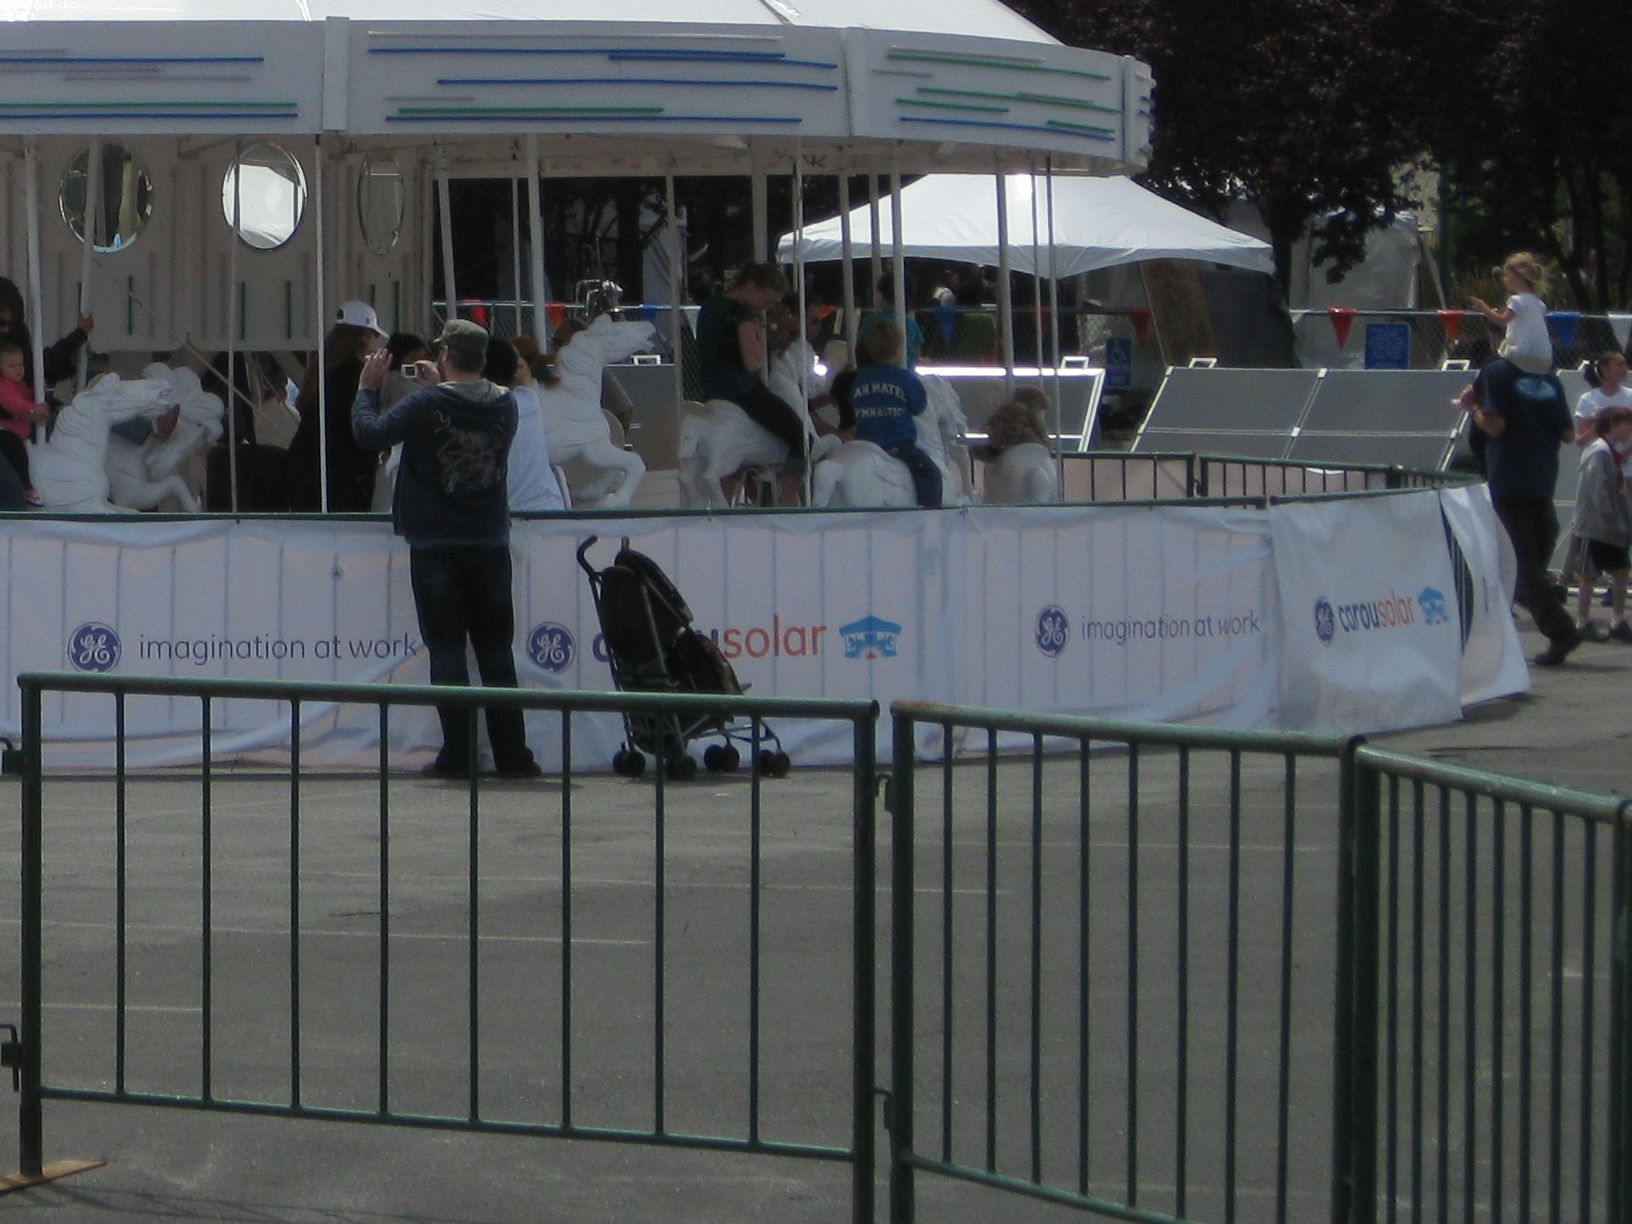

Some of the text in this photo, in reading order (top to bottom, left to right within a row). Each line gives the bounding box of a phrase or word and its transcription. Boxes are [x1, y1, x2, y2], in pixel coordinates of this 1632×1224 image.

[1081, 614, 1192, 646] imagination
[1195, 615, 1216, 638] at
[1218, 609, 1263, 637] work
[1338, 587, 1416, 633] carousolar
[139, 633, 306, 666] imagination
[313, 635, 343, 660] at
[348, 632, 419, 659] work
